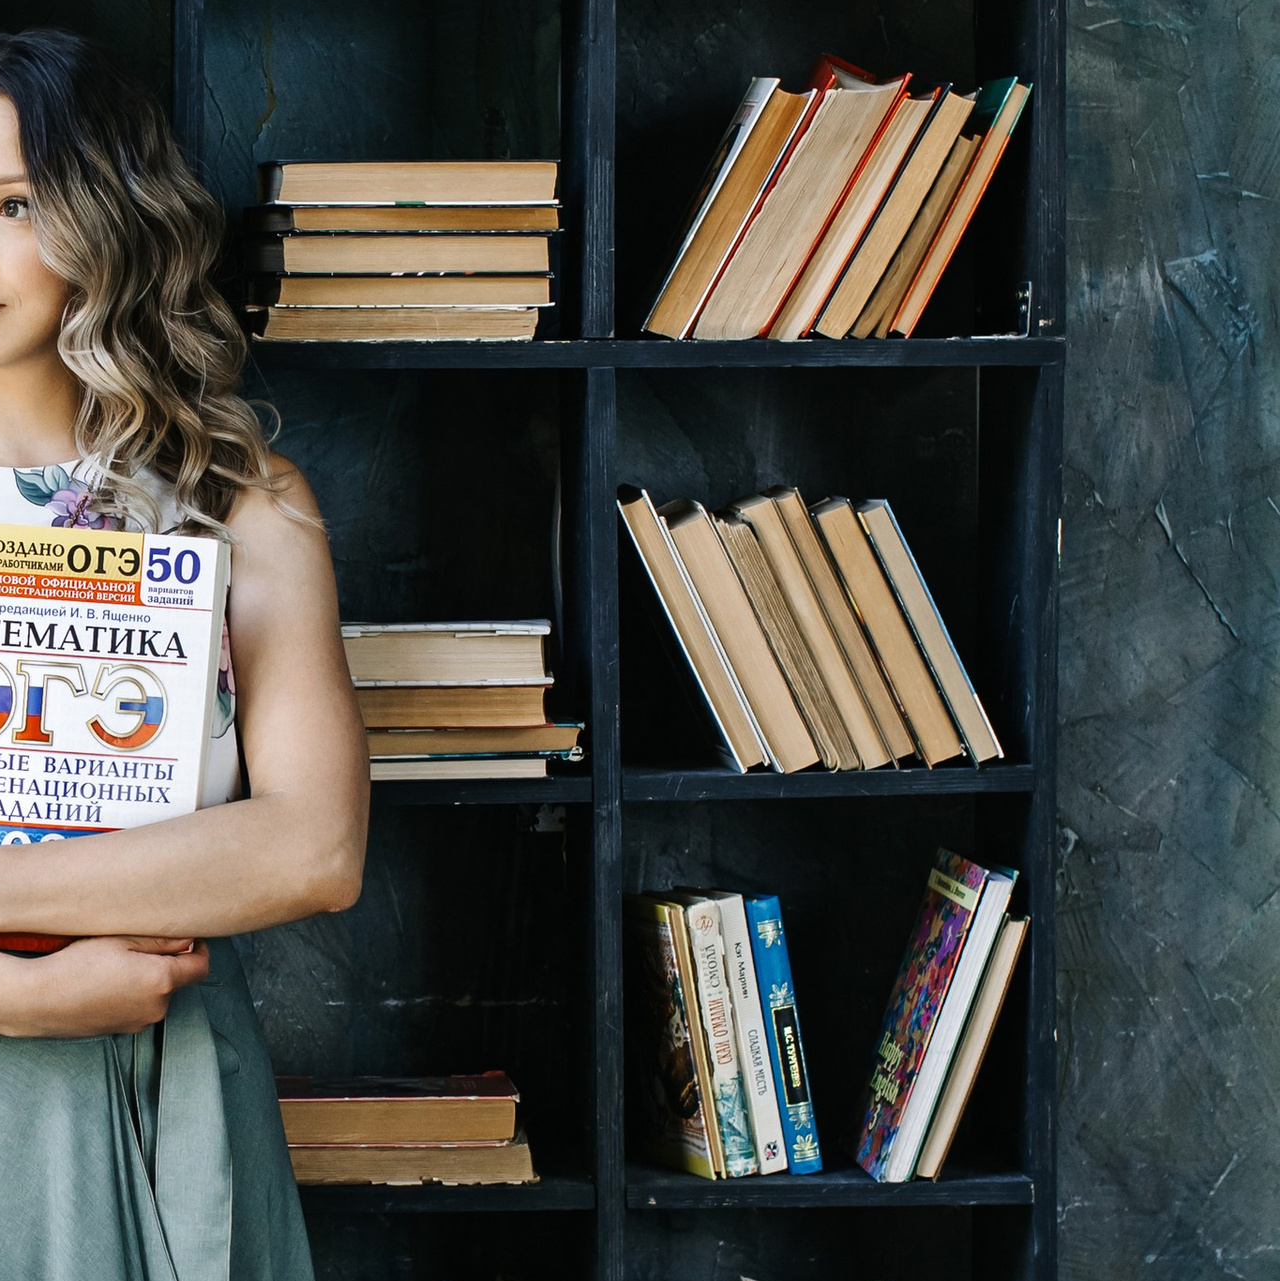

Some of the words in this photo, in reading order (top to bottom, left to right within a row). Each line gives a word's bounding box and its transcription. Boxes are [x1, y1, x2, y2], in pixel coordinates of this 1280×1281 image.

[67, 544, 140, 577] ОГЭ
[146, 546, 201, 585] 50
[40, 577, 136, 594] ОФИЦИАЛЬНОЙ
[96, 591, 136, 603] ВЕРСИИ
[147, 586, 194, 596] вариантов
[0, 603, 67, 618] редакцией
[70, 607, 83, 618] И.
[86, 610, 99, 620] В.
[102, 609, 151, 624] Ященко
[147, 595, 194, 607] заданий
[43, 756, 175, 782] ВАРИАНТЫ
[734, 942, 743, 959] Кэт
[705, 943, 721, 988] СМОЛЛ
[748, 1029, 763, 1067] СЛАДКАЯ
[878, 1031, 905, 1076] Happy
[755, 1069, 768, 1097] МЕСТЬ
[871, 1064, 901, 1106] English
